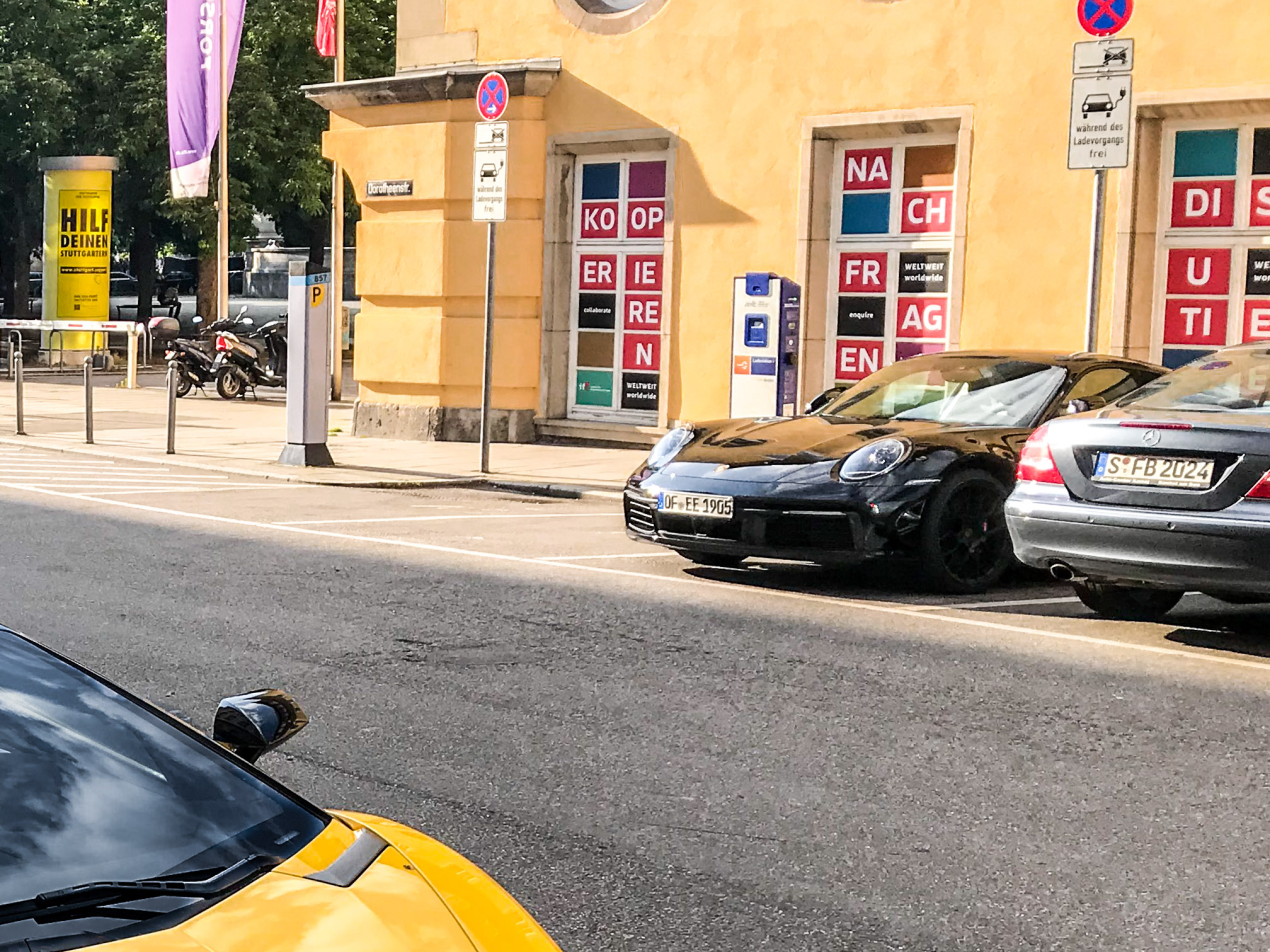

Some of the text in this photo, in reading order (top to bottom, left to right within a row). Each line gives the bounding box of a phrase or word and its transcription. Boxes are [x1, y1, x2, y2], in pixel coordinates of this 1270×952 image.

[1076, 122, 1123, 133] während des
[1073, 136, 1124, 146] Ladevorgangs
[1089, 149, 1107, 158] frei
[847, 155, 888, 183] NA
[368, 182, 411, 194] Dorotheenstr.
[907, 197, 946, 224] CH
[1185, 187, 1221, 217] DI
[61, 208, 108, 232] HILF
[584, 207, 664, 230] KO OP
[60, 234, 108, 248] DEINEN
[583, 261, 656, 284] ER IE
[845, 259, 881, 285] FR
[904, 262, 944, 271] WELTWEIT
[904, 273, 944, 282] worldwide
[1186, 257, 1212, 286] U
[314, 274, 327, 282] 857
[312, 286, 321, 303] P
[629, 301, 659, 324] RE
[849, 311, 874, 319] enquire
[901, 304, 942, 331] AG
[1180, 307, 1212, 336] TI
[636, 343, 653, 365] N
[840, 347, 879, 373] EN
[626, 382, 657, 390] WELTWEIT
[626, 392, 657, 400] worldwide
[1108, 456, 1121, 474] S
[1131, 458, 1158, 477] FB
[1159, 459, 1209, 480] 2024
[664, 494, 731, 515] OF EE 1905
